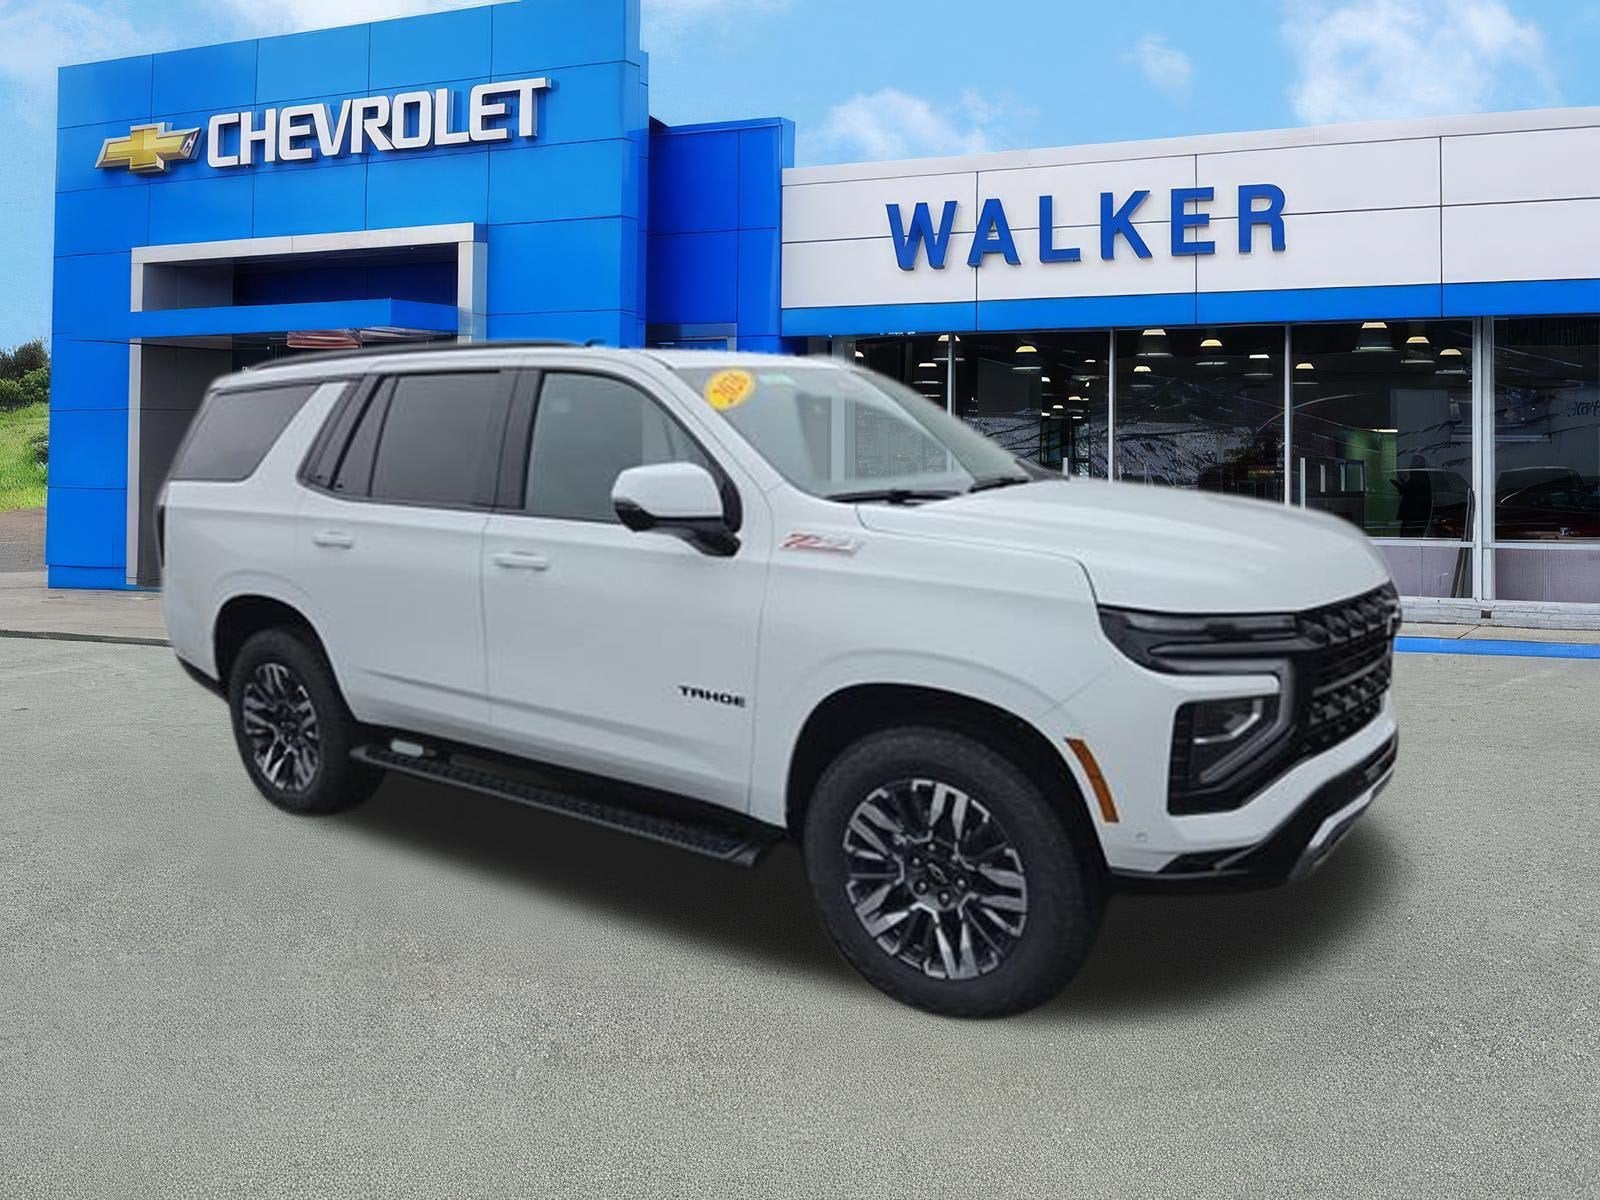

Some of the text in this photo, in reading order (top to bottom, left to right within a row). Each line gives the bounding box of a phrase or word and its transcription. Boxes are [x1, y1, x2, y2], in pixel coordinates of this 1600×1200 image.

[207, 77, 551, 168] CHEVROLET
[886, 184, 1287, 271] WALKER
[678, 685, 746, 708] TAHOE
